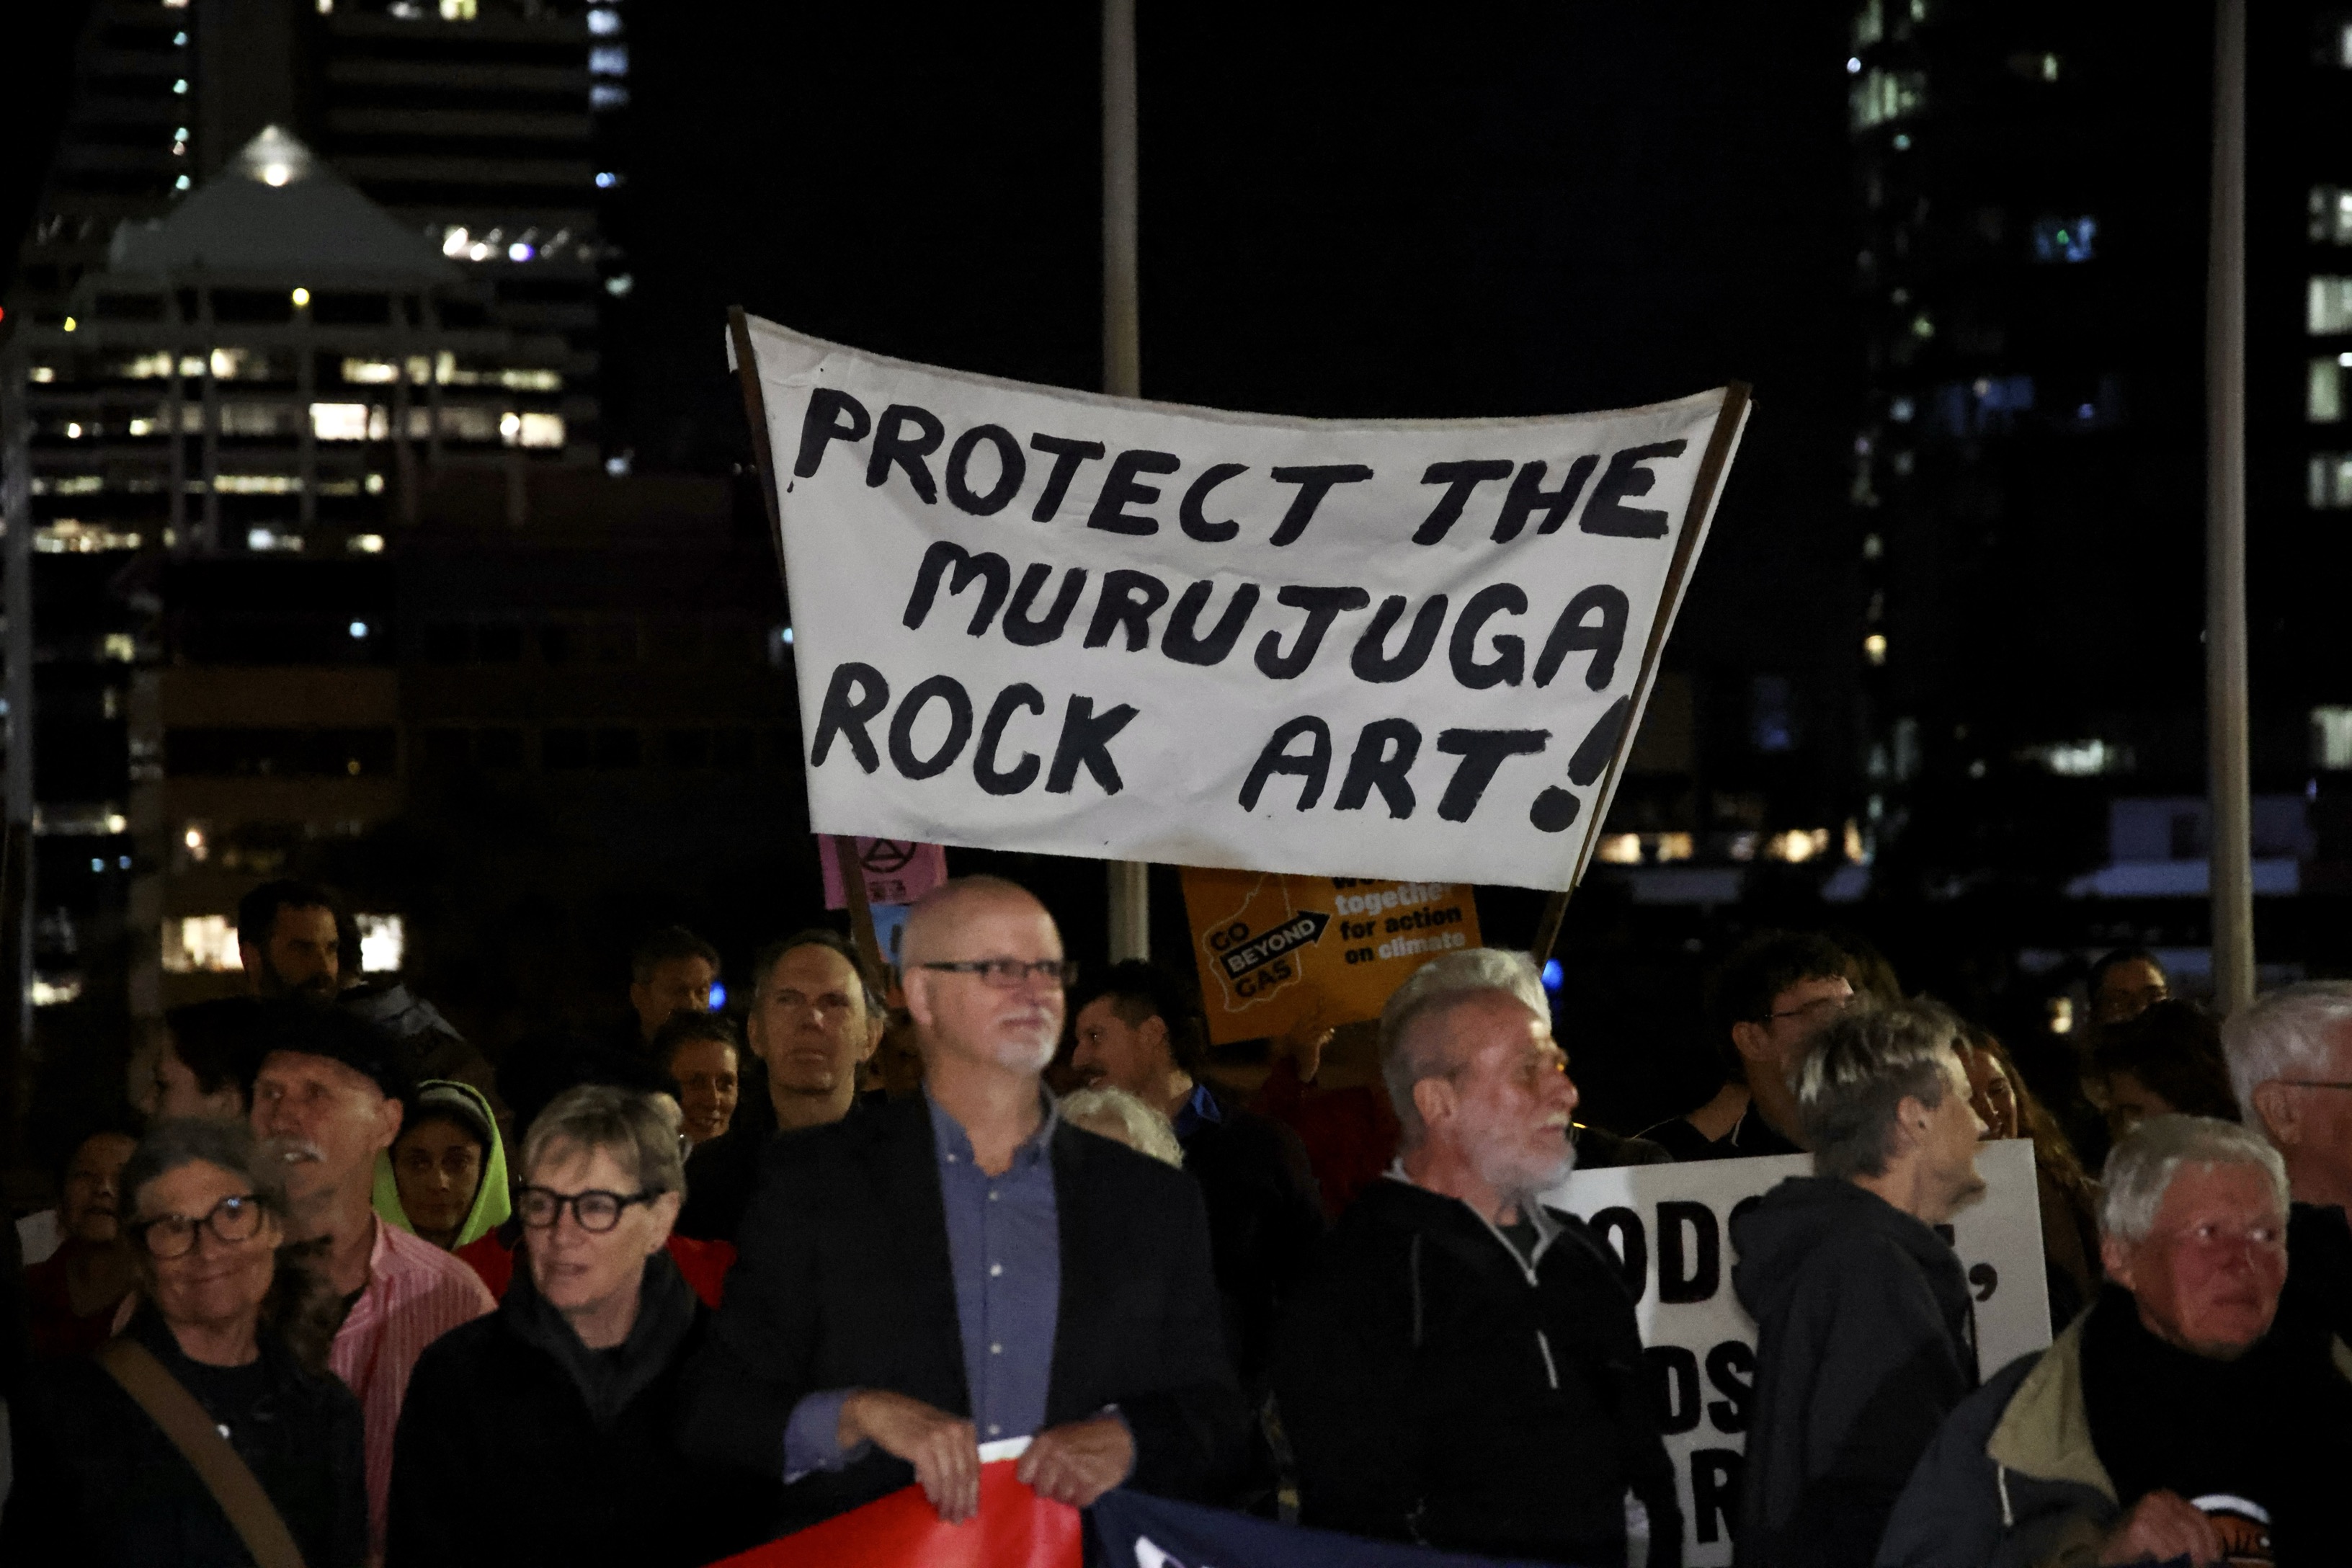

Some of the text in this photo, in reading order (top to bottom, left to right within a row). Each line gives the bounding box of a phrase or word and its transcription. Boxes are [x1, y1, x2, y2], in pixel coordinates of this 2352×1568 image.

[793, 388, 1688, 546] PROTECT THE
[903, 541, 1630, 692] MURUJUGA
[811, 662, 1631, 833] ROCK ART!
[1210, 922, 1249, 951] GO
[1226, 918, 1316, 973] BEYOND
[1340, 906, 1462, 940] for action
[1345, 932, 1466, 964] on climate
[1235, 959, 1291, 997] GAS
